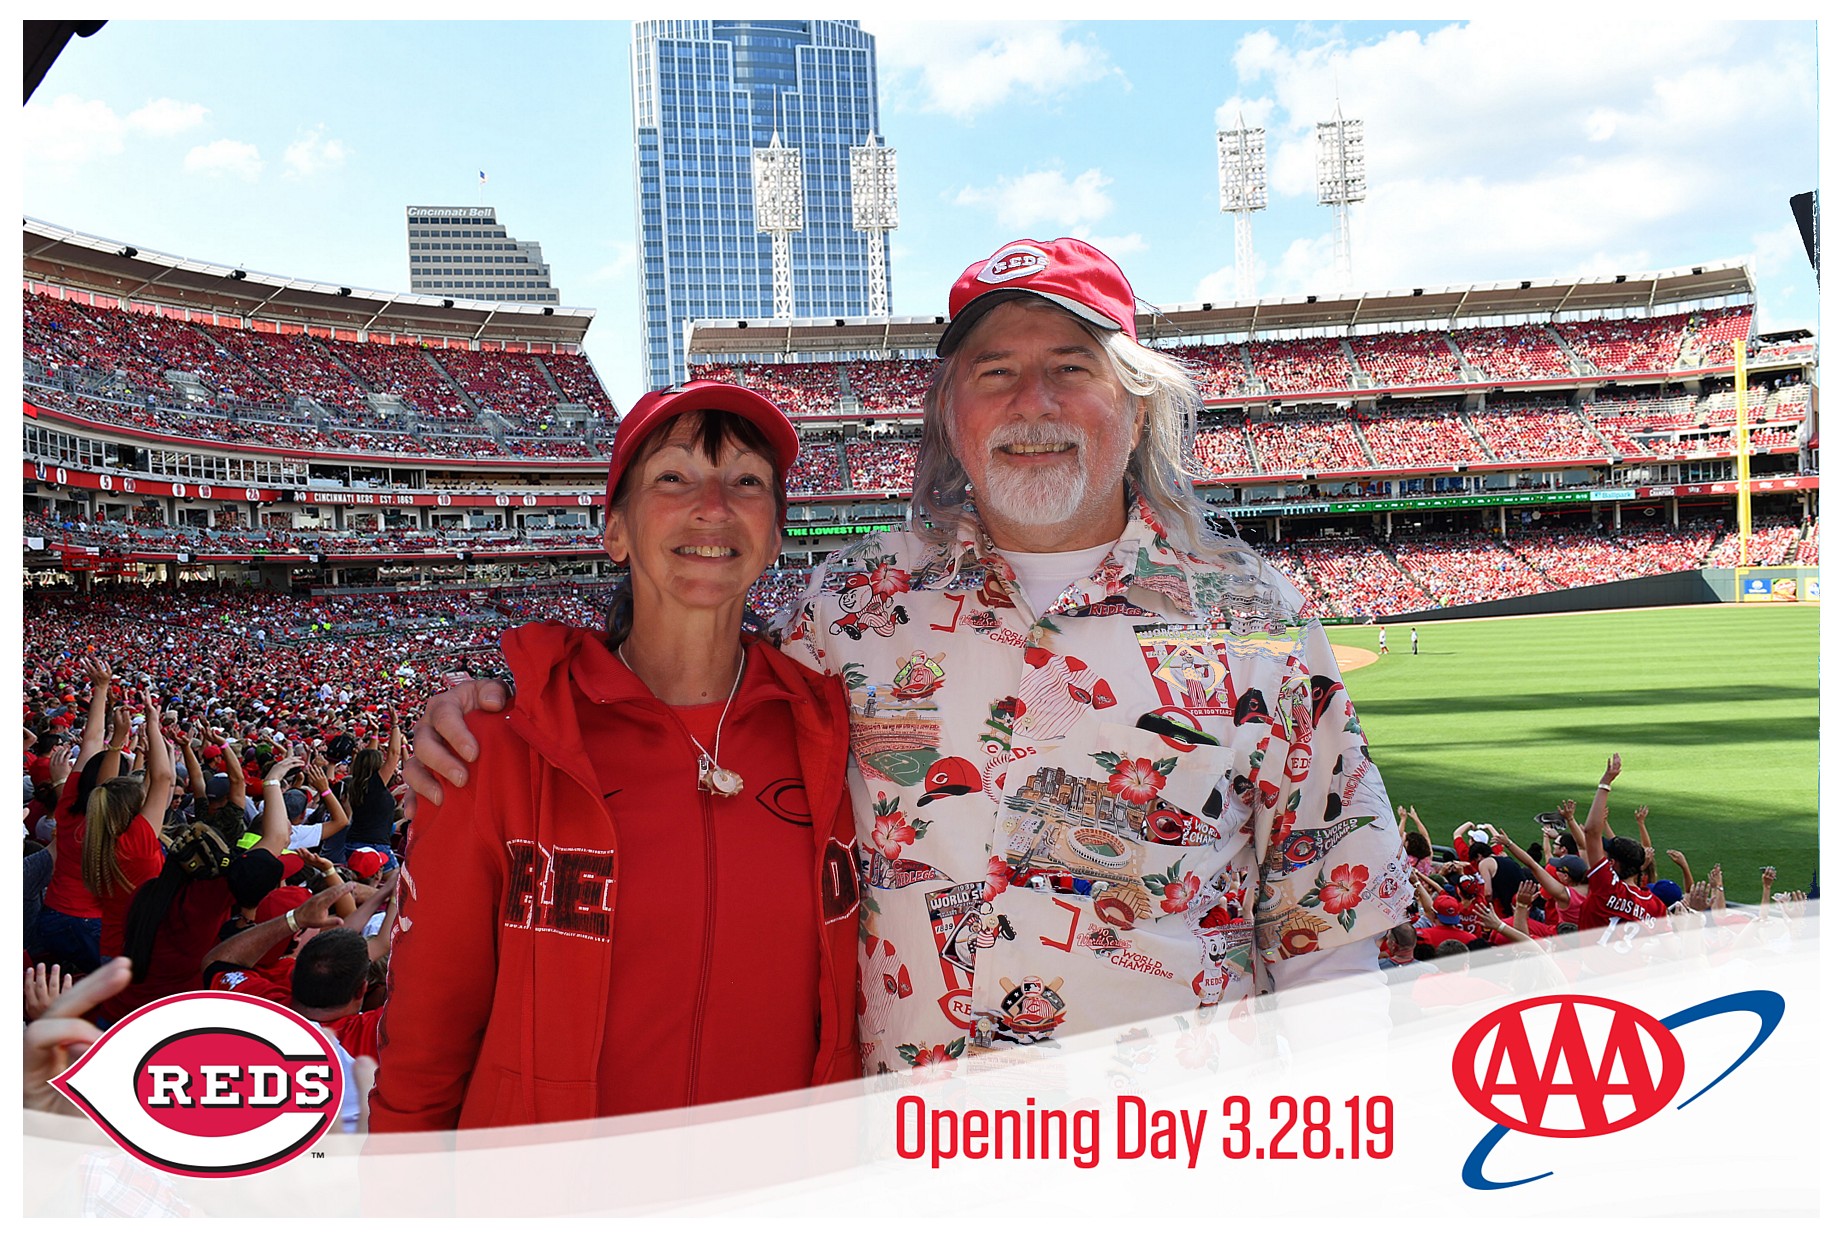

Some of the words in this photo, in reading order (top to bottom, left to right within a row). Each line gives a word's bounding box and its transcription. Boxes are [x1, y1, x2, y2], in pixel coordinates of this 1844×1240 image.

[407, 207, 467, 216] Cincinnati
[469, 208, 492, 217] Bell
[993, 255, 1048, 274] REDS
[314, 493, 354, 502] CINCINNATI
[787, 528, 807, 536] THE
[809, 526, 853, 535] LOWEST
[930, 892, 969, 910] WORLD
[1110, 956, 1174, 979] CHAMPIONS
[1122, 948, 1162, 969] WORLD
